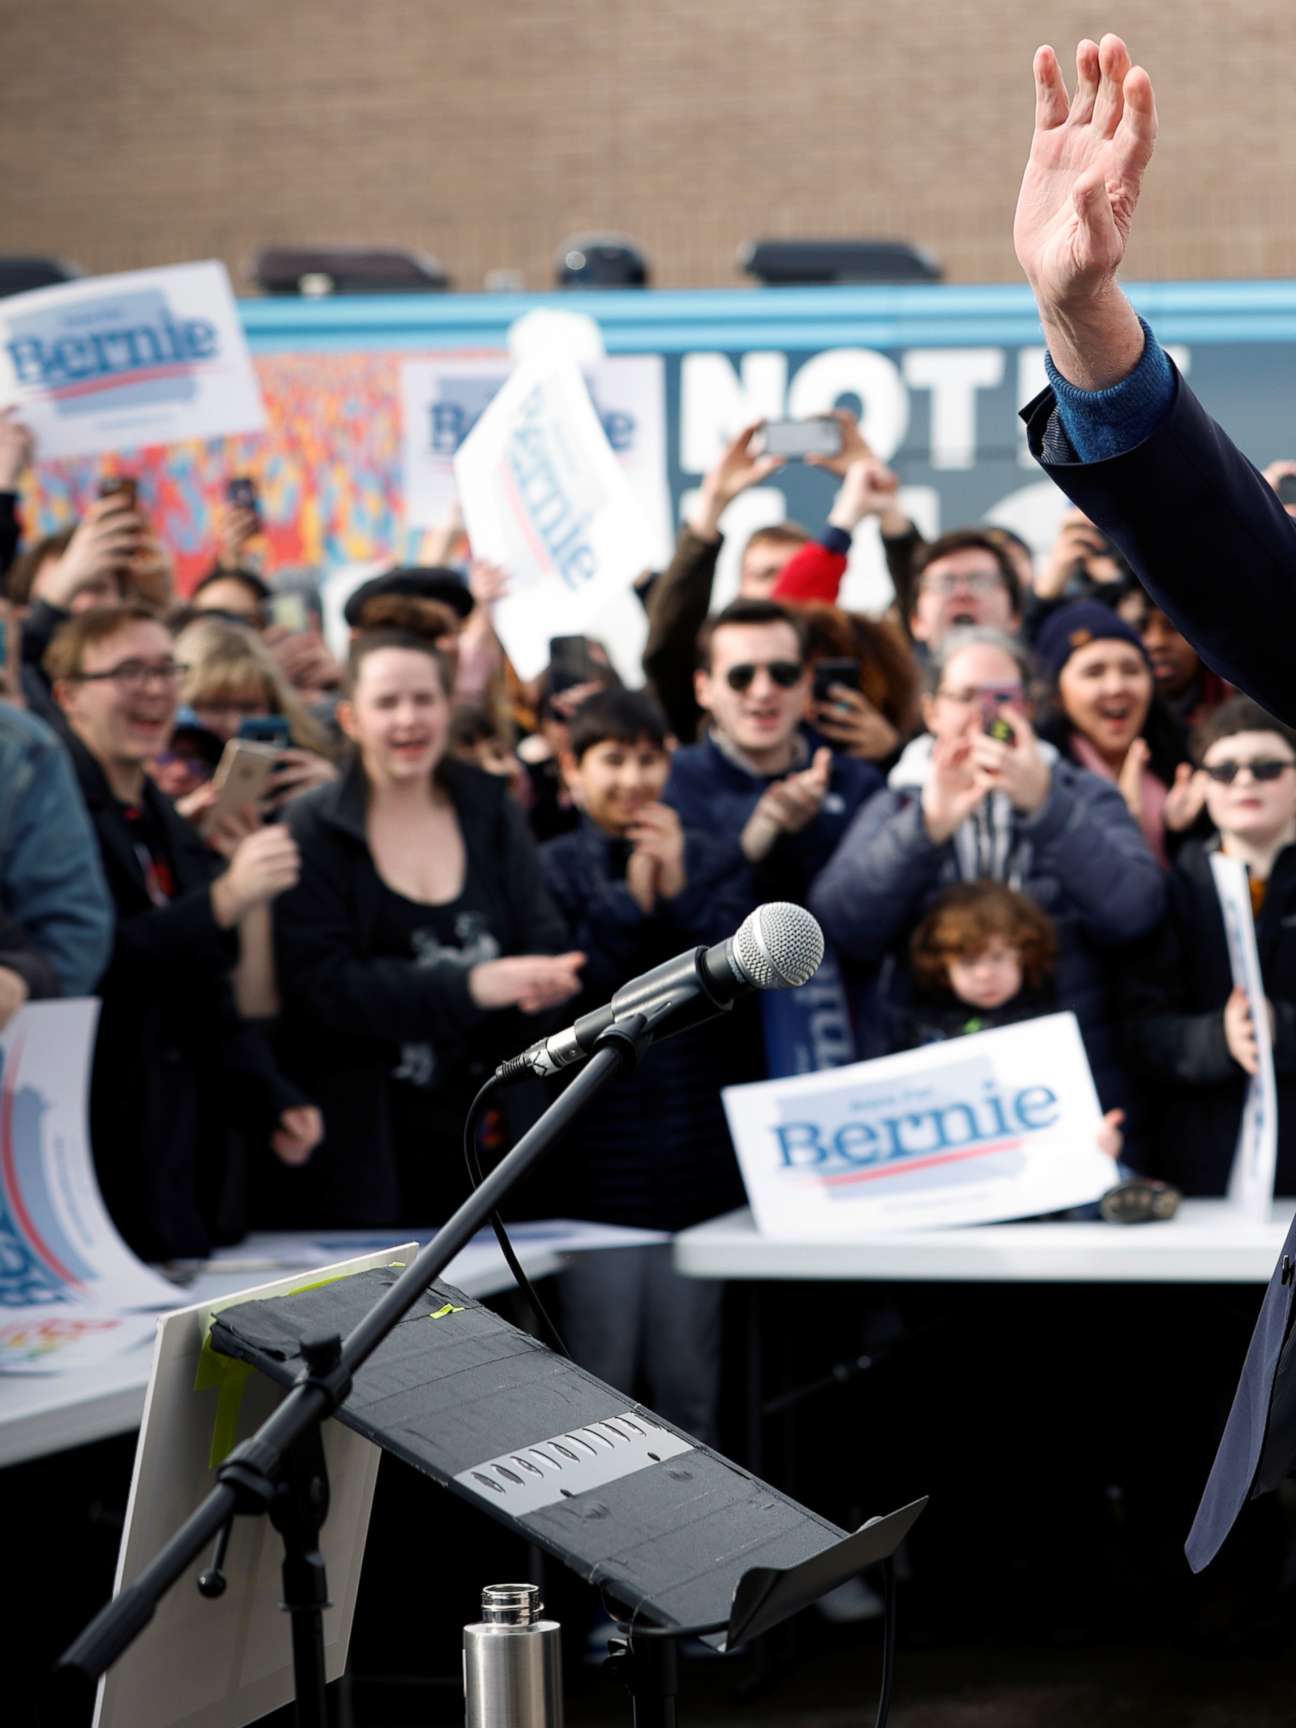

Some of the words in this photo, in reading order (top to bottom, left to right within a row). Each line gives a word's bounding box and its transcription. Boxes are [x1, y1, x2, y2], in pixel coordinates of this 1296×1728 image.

[7, 306, 219, 385] Bernie
[681, 347, 1004, 474] NOT
[770, 1080, 1060, 1168] Bernie
